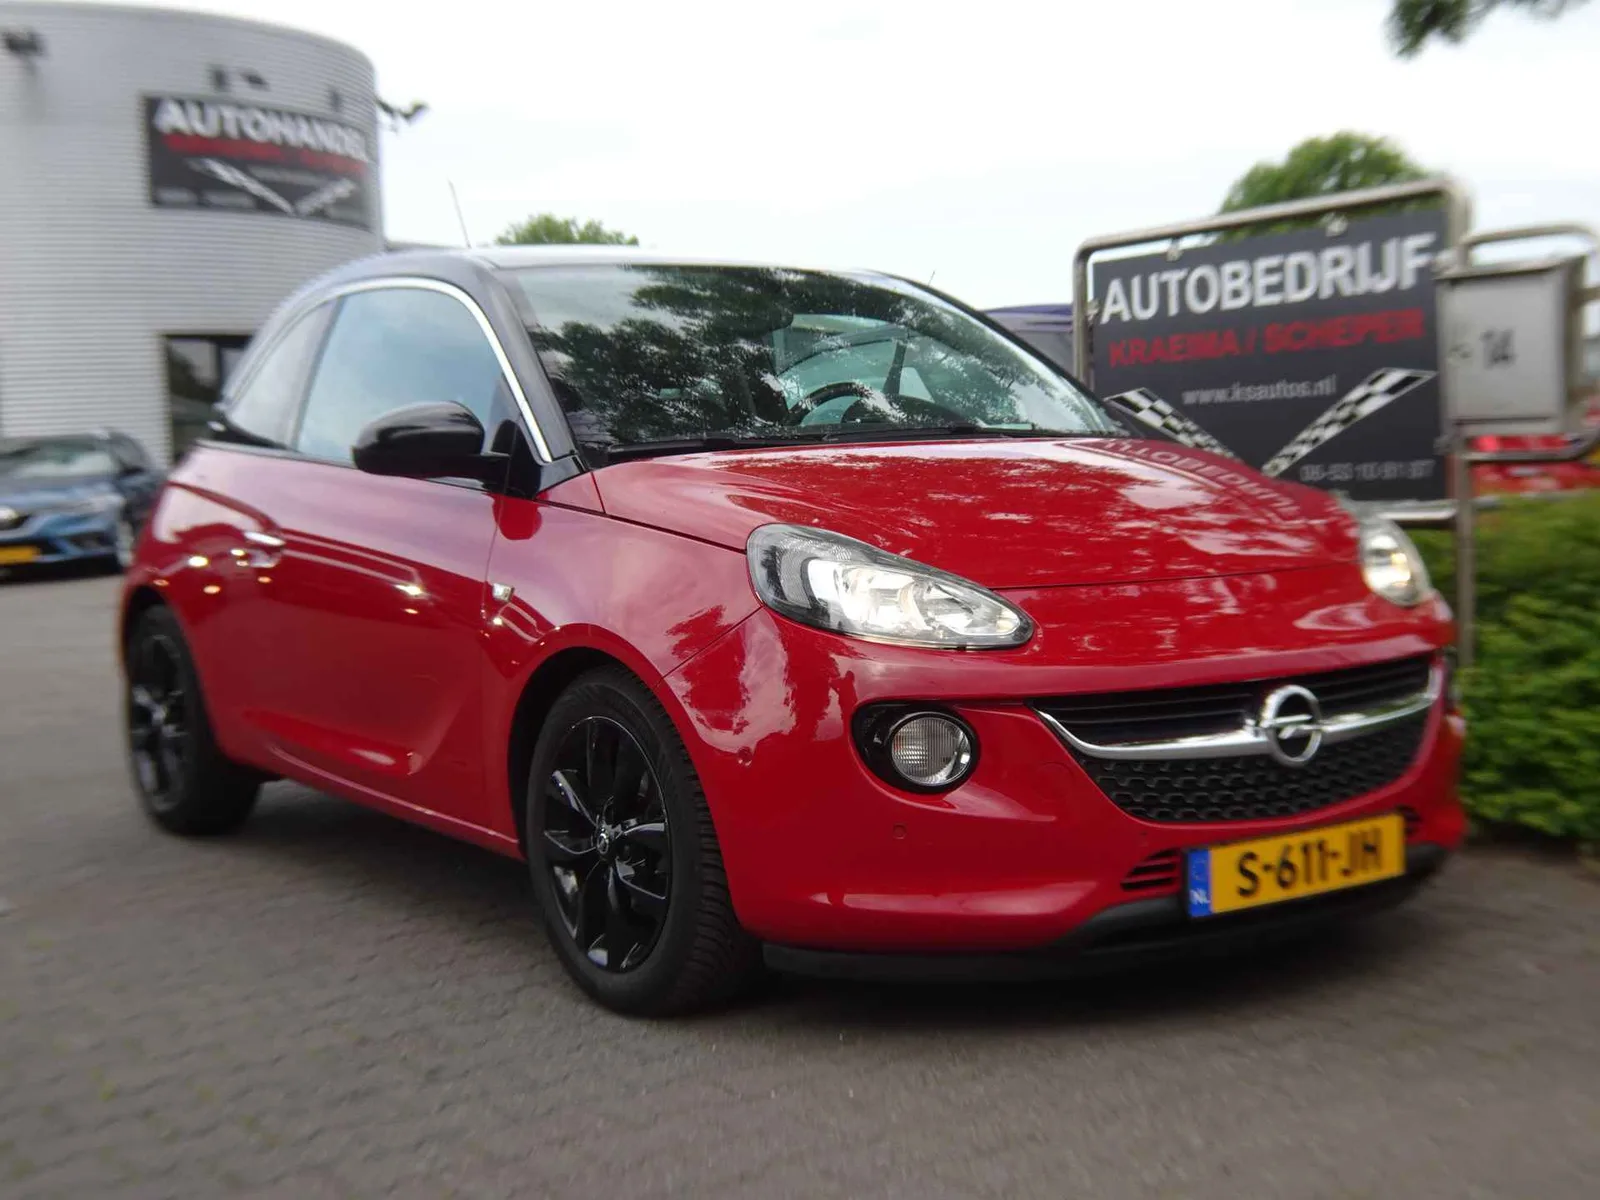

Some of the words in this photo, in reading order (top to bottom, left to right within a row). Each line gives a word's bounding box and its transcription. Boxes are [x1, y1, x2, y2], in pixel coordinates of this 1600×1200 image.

[1101, 232, 1438, 325] AUTOBEDRIJF
[1264, 307, 1426, 354] SCHEPER
[1182, 374, 1338, 405] www.ksautos.nl
[1237, 827, 1382, 898] S-611-JH
